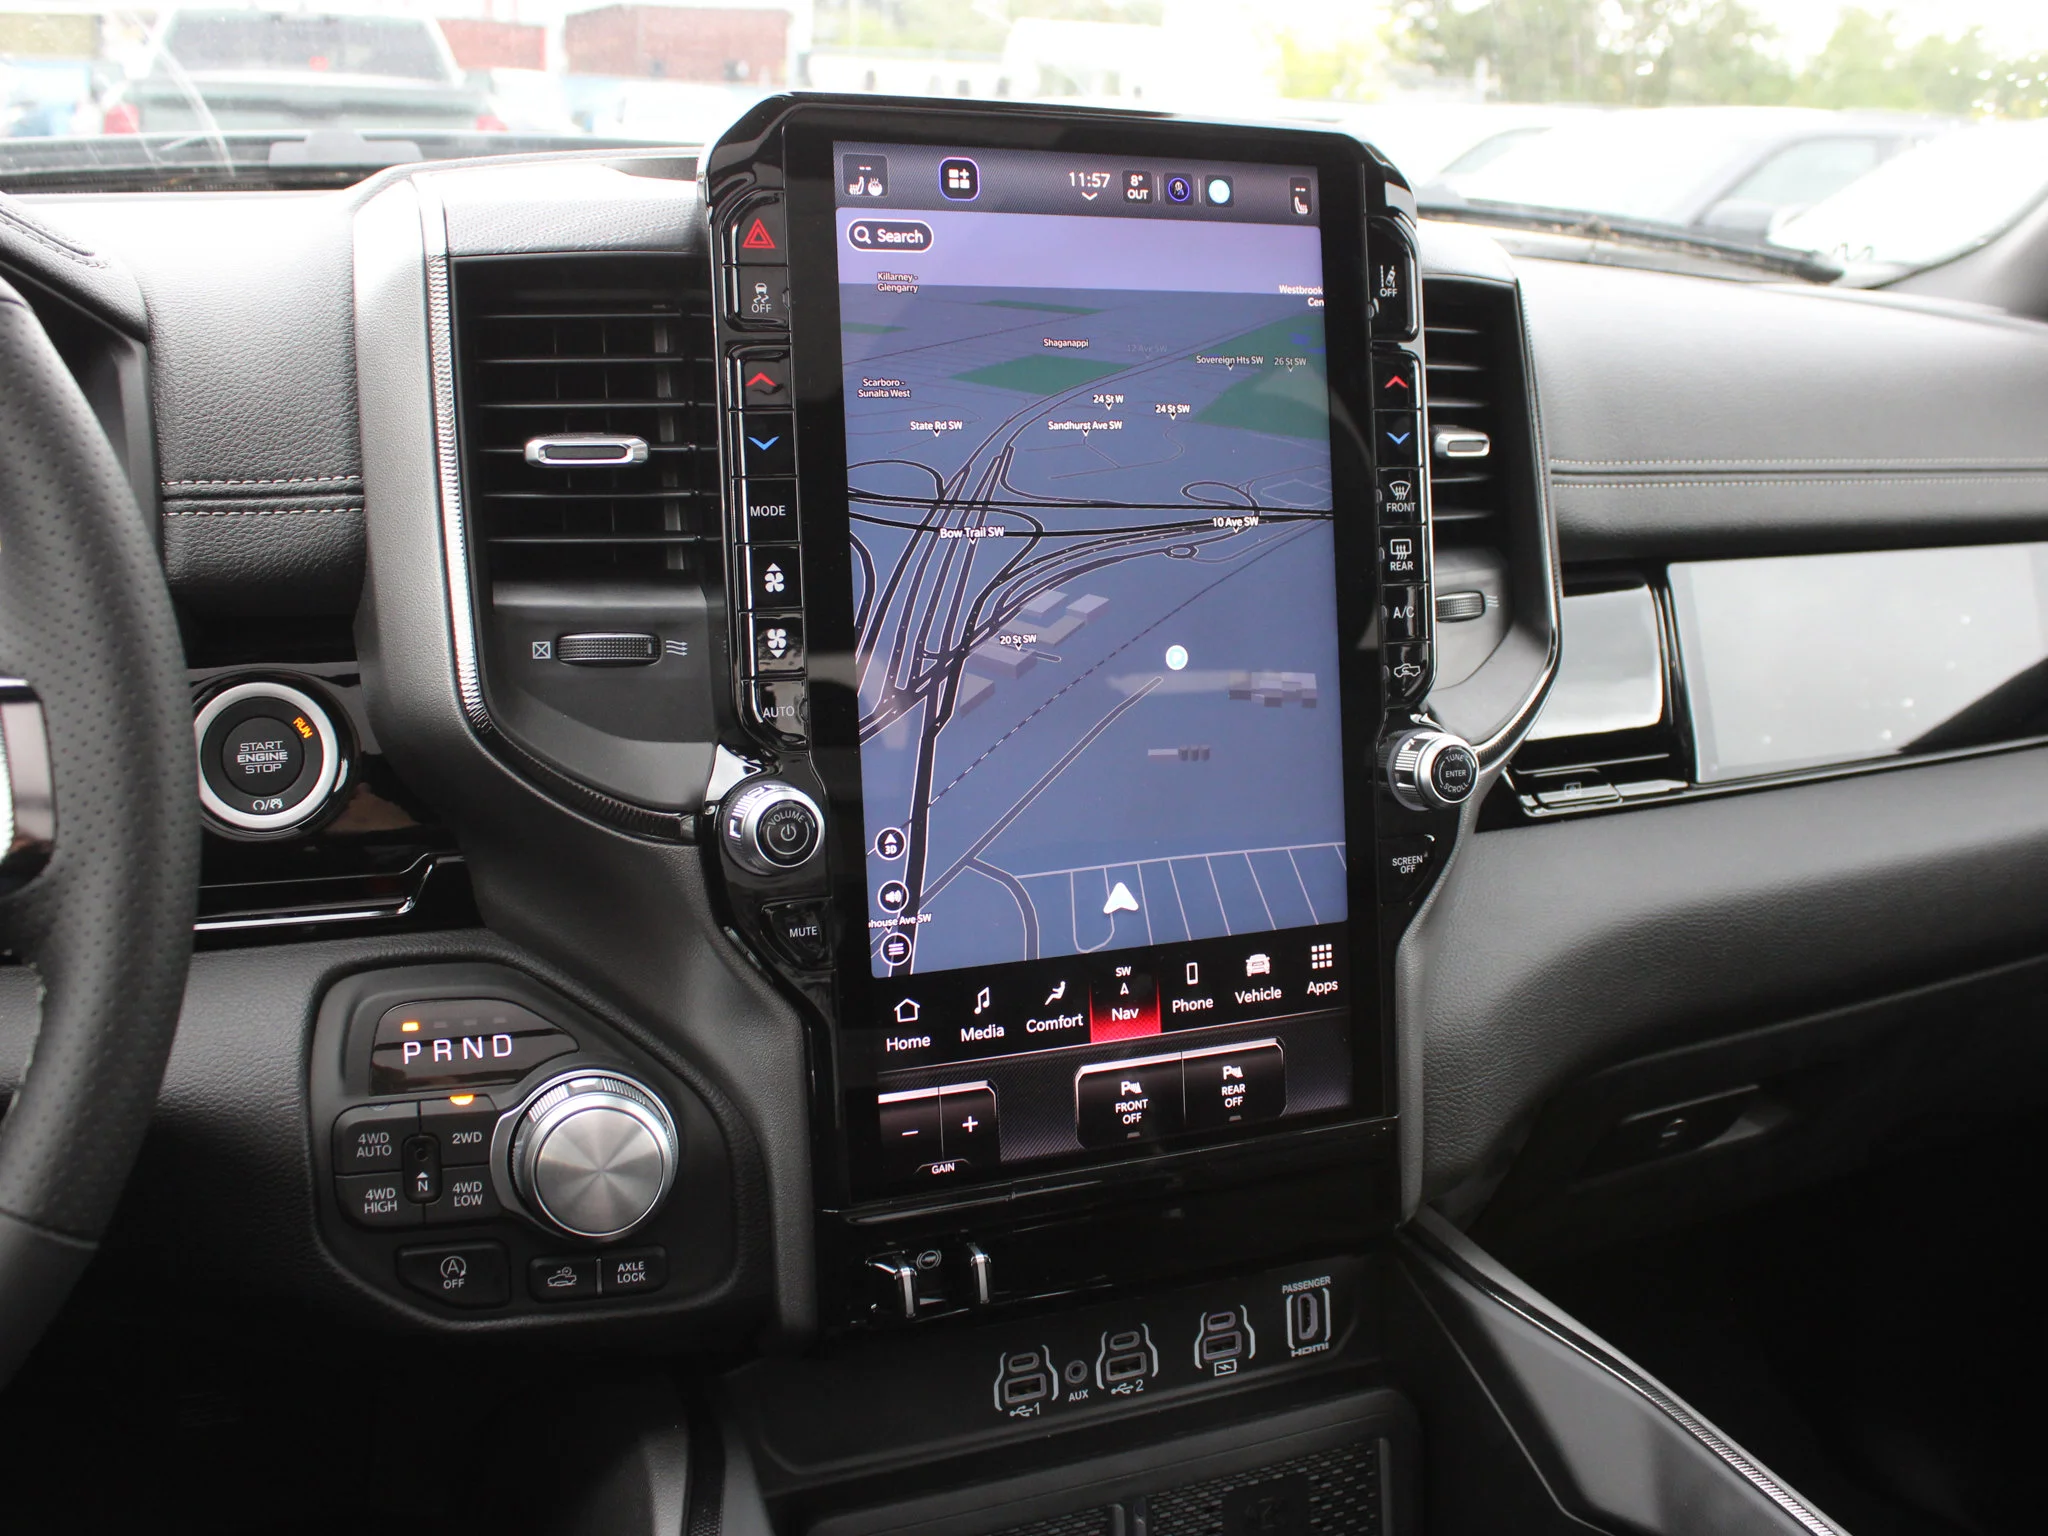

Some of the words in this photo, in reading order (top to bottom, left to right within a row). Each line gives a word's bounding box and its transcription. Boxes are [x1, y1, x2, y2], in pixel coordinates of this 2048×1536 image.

[1068, 172, 1111, 189] 11:57
[1127, 188, 1149, 200] OUT
[877, 229, 923, 243] Search
[877, 272, 913, 283] Killarney
[877, 283, 919, 293] Glengarry
[1278, 284, 1323, 295] Westbrook
[1379, 288, 1398, 298] OFF
[751, 304, 772, 314] OFF
[1043, 338, 1089, 349] Shaganappi
[1196, 355, 1235, 365] Sovereign
[1236, 356, 1250, 364] Hts
[1251, 356, 1264, 364] SW
[1274, 357, 1284, 365] 26
[1285, 358, 1293, 366] St
[1294, 358, 1307, 366] SW
[862, 378, 900, 387] Scarboro
[857, 389, 889, 398] Sunalta
[890, 389, 911, 398] West
[1093, 395, 1104, 403] 24
[1105, 395, 1114, 403] St
[1115, 395, 1124, 403] W
[1155, 404, 1166, 413] 24
[1167, 404, 1176, 413] St
[1177, 405, 1190, 413] SW
[910, 421, 933, 430] State
[934, 421, 947, 430] Rd
[948, 421, 963, 430] SW
[1048, 421, 1091, 430] Sandhurst
[1093, 421, 1107, 430] Ave
[1109, 421, 1123, 430] SW
[750, 505, 786, 517] MODE
[1386, 502, 1416, 512] FRONT
[1212, 517, 1223, 528] 10
[1224, 517, 1241, 528] Ave
[1243, 516, 1259, 527] SW
[939, 527, 961, 539] Bow
[963, 526, 986, 538] Trail
[988, 526, 1005, 537] SW
[1390, 561, 1414, 571] REAR
[1393, 606, 1415, 619] A/C
[999, 635, 1011, 645] 20
[1012, 634, 1022, 645] St
[1023, 633, 1037, 644] SW
[762, 705, 795, 719] AUTO
[292, 716, 313, 739] RUN
[239, 740, 283, 752] START
[236, 751, 288, 763] ENGINE
[1445, 753, 1465, 763] TUNE
[245, 763, 282, 774] STOP
[1445, 769, 1467, 778] ENTER
[1443, 782, 1469, 793] SCROLL
[767, 809, 806, 827] VOLUME
[884, 844, 897, 854] 3D
[1392, 855, 1423, 866] SCREEN
[1400, 864, 1416, 874] OFF
[868, 918, 898, 928] house
[899, 916, 916, 925] Ave
[917, 913, 932, 923] SW
[789, 925, 818, 938] MUTE
[1115, 965, 1132, 977] SW
[1307, 978, 1338, 996] Apps
[1234, 985, 1282, 1005] Vehicle
[1171, 995, 1214, 1013] Phone
[1111, 1006, 1139, 1021] Nav
[1025, 1012, 1084, 1033] Comfort
[960, 1023, 1005, 1042] Media
[403, 1041, 422, 1064] P
[433, 1038, 453, 1063] R
[462, 1036, 483, 1060] N
[491, 1034, 513, 1057] D
[886, 1034, 931, 1052] Home
[1221, 1083, 1246, 1096] REAR
[1115, 1099, 1148, 1113] FRONT
[1224, 1095, 1243, 1108] OFF
[1122, 1112, 1142, 1124] OFF
[357, 1131, 390, 1145] 4WD
[452, 1131, 483, 1144] 2WD
[356, 1144, 392, 1158] AUTO
[931, 1162, 955, 1174] GAIN
[417, 1180, 429, 1192] N
[452, 1181, 483, 1194] 4WD
[365, 1187, 396, 1201] 4WD
[453, 1193, 483, 1207] LOW
[364, 1200, 398, 1214] HIGH
[617, 1261, 645, 1273] AXLE
[443, 1277, 465, 1289] OFF
[617, 1270, 646, 1284] LOCK
[1282, 1276, 1332, 1295] PASSENGER
[1135, 1379, 1144, 1393] 2
[1068, 1388, 1089, 1402] AUX
